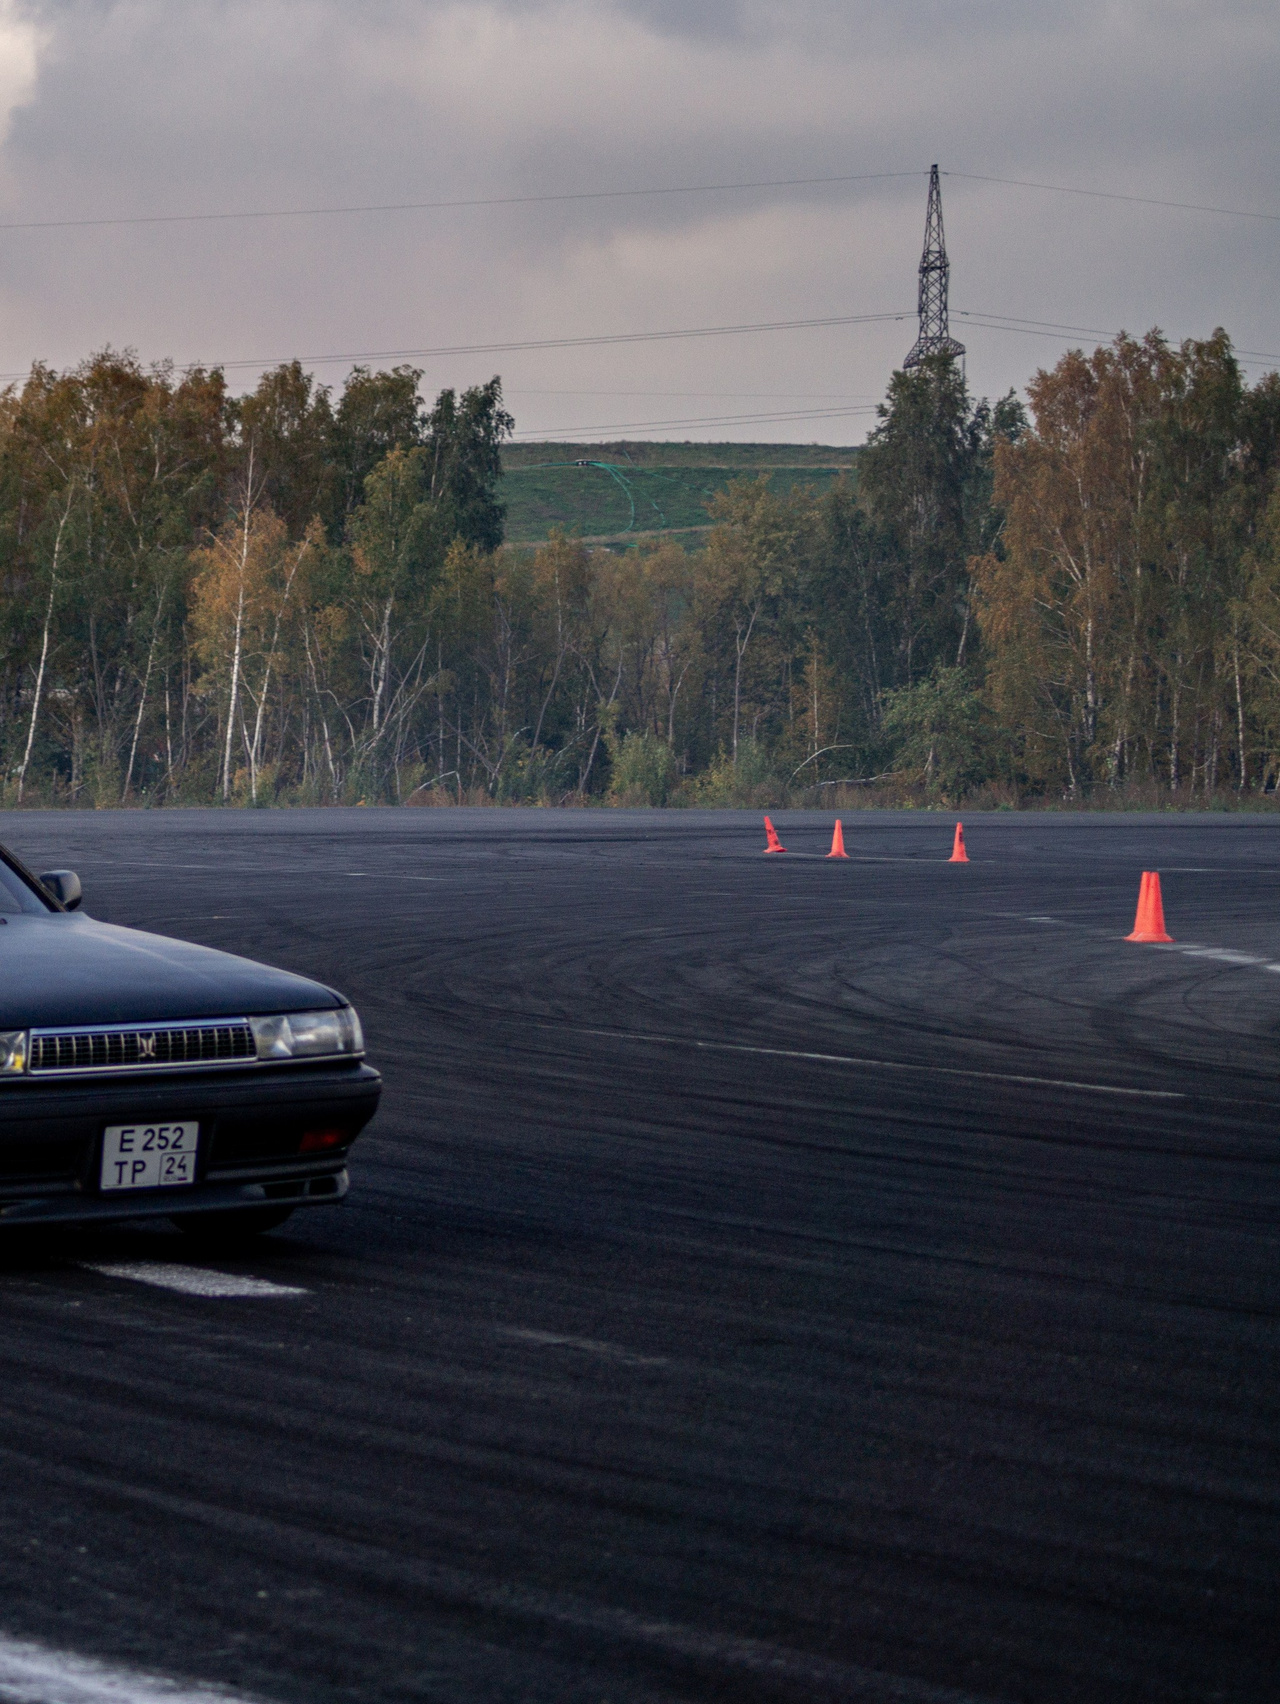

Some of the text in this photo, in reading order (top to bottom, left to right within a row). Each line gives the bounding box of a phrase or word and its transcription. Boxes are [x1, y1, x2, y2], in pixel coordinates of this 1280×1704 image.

[119, 1127, 184, 1152] E 252
[114, 1156, 186, 1184] TP 24
